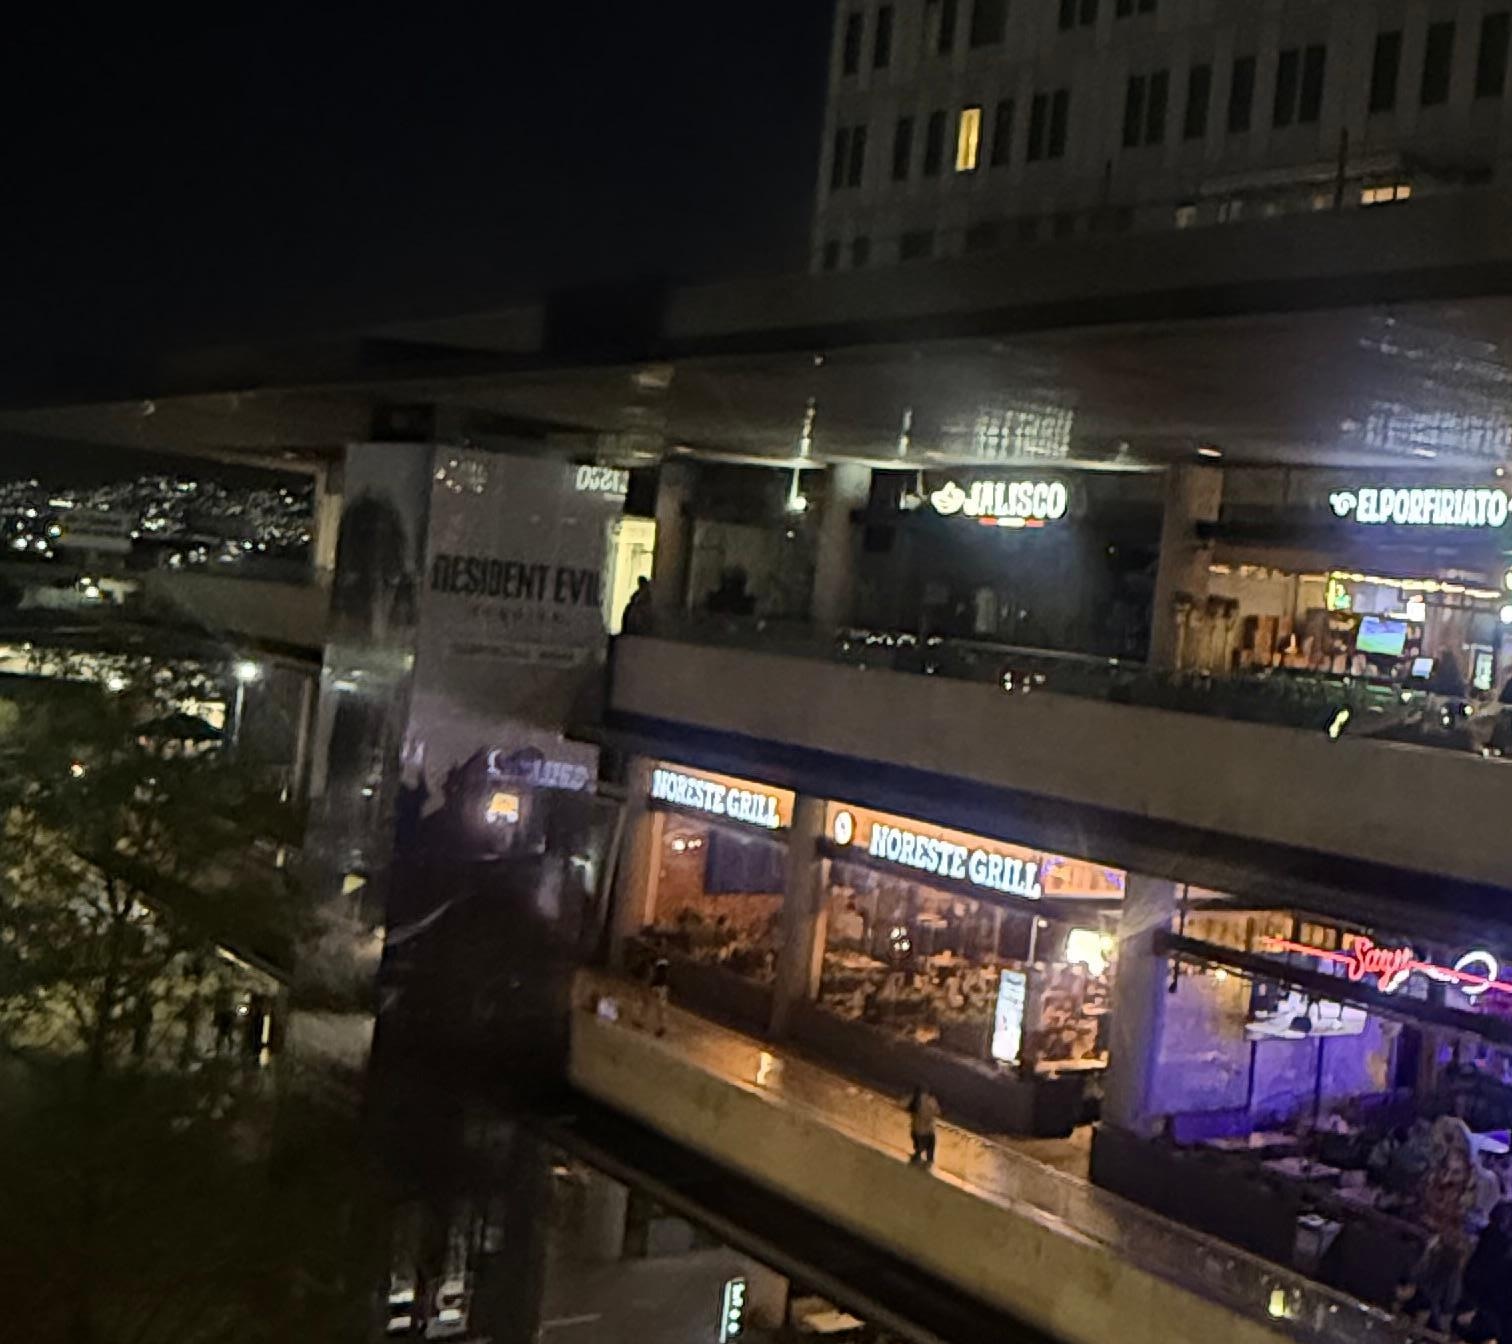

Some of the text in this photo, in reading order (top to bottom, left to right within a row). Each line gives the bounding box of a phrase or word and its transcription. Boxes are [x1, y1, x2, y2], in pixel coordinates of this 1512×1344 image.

[963, 480, 1067, 519] JALISCO
[432, 555, 550, 602] RESIDENT
[652, 769, 779, 829] NORESTE GRILL
[869, 822, 1042, 900] NORESTE GRILL
